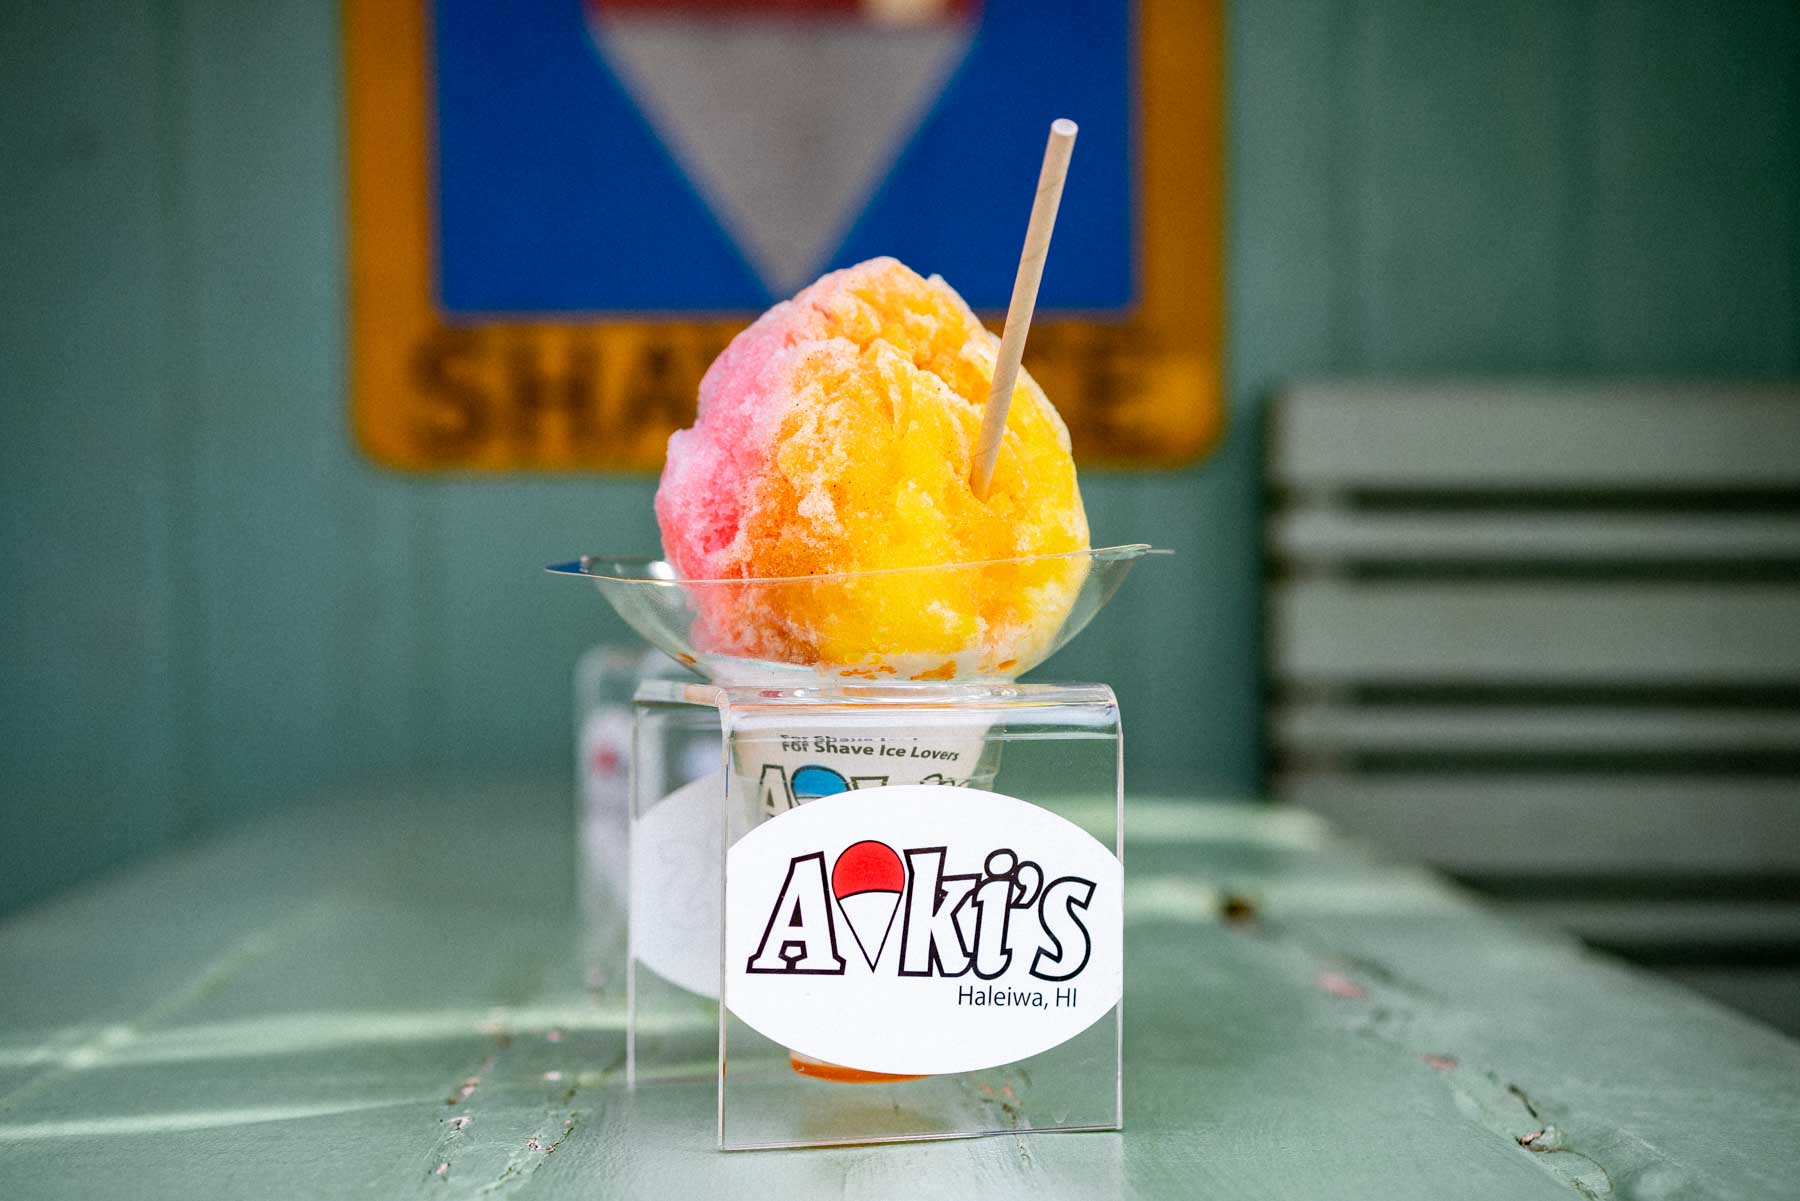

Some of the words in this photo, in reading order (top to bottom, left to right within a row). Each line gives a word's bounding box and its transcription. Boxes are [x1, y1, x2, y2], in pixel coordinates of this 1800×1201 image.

[408, 332, 735, 458] SHA
[814, 739, 875, 755] Shave
[880, 744, 906, 757] Ice
[911, 746, 960, 761] Lovers
[958, 985, 1049, 1010] Haleiwa,
[1056, 987, 1077, 1008] HI
